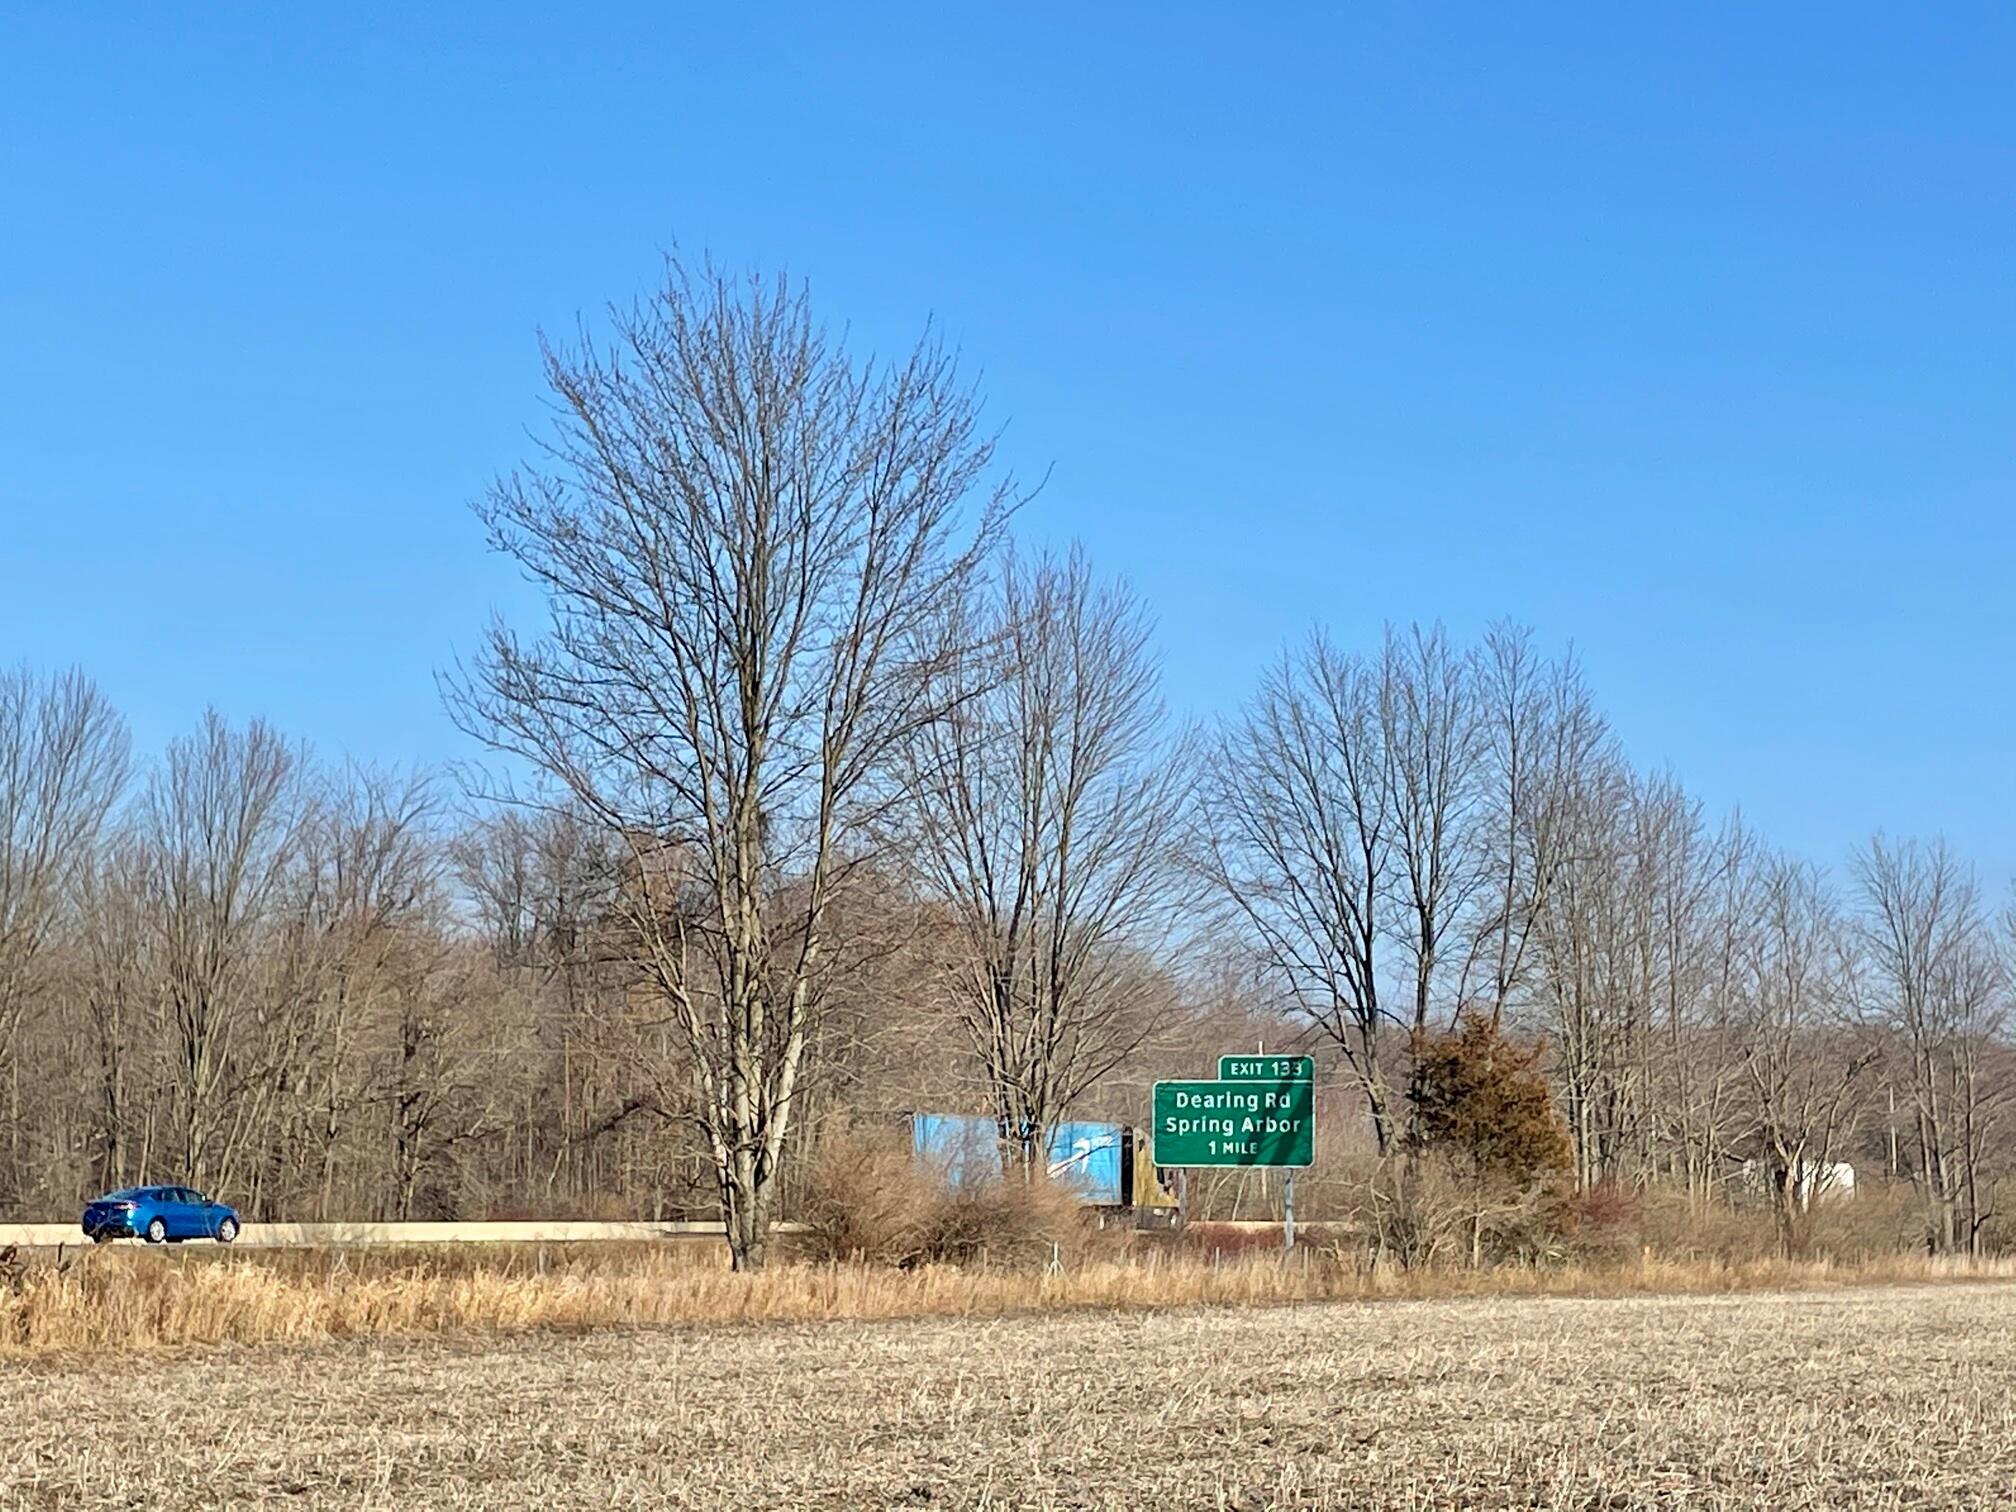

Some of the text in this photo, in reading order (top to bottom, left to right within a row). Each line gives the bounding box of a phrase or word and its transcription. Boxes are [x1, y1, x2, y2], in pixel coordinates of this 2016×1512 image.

[1230, 1061, 1302, 1076] EXIT 133
[1176, 1091, 1291, 1112] Dearing Rd
[1166, 1116, 1301, 1137] Spring Arbor
[1208, 1141, 1258, 1155] 1 MILE
